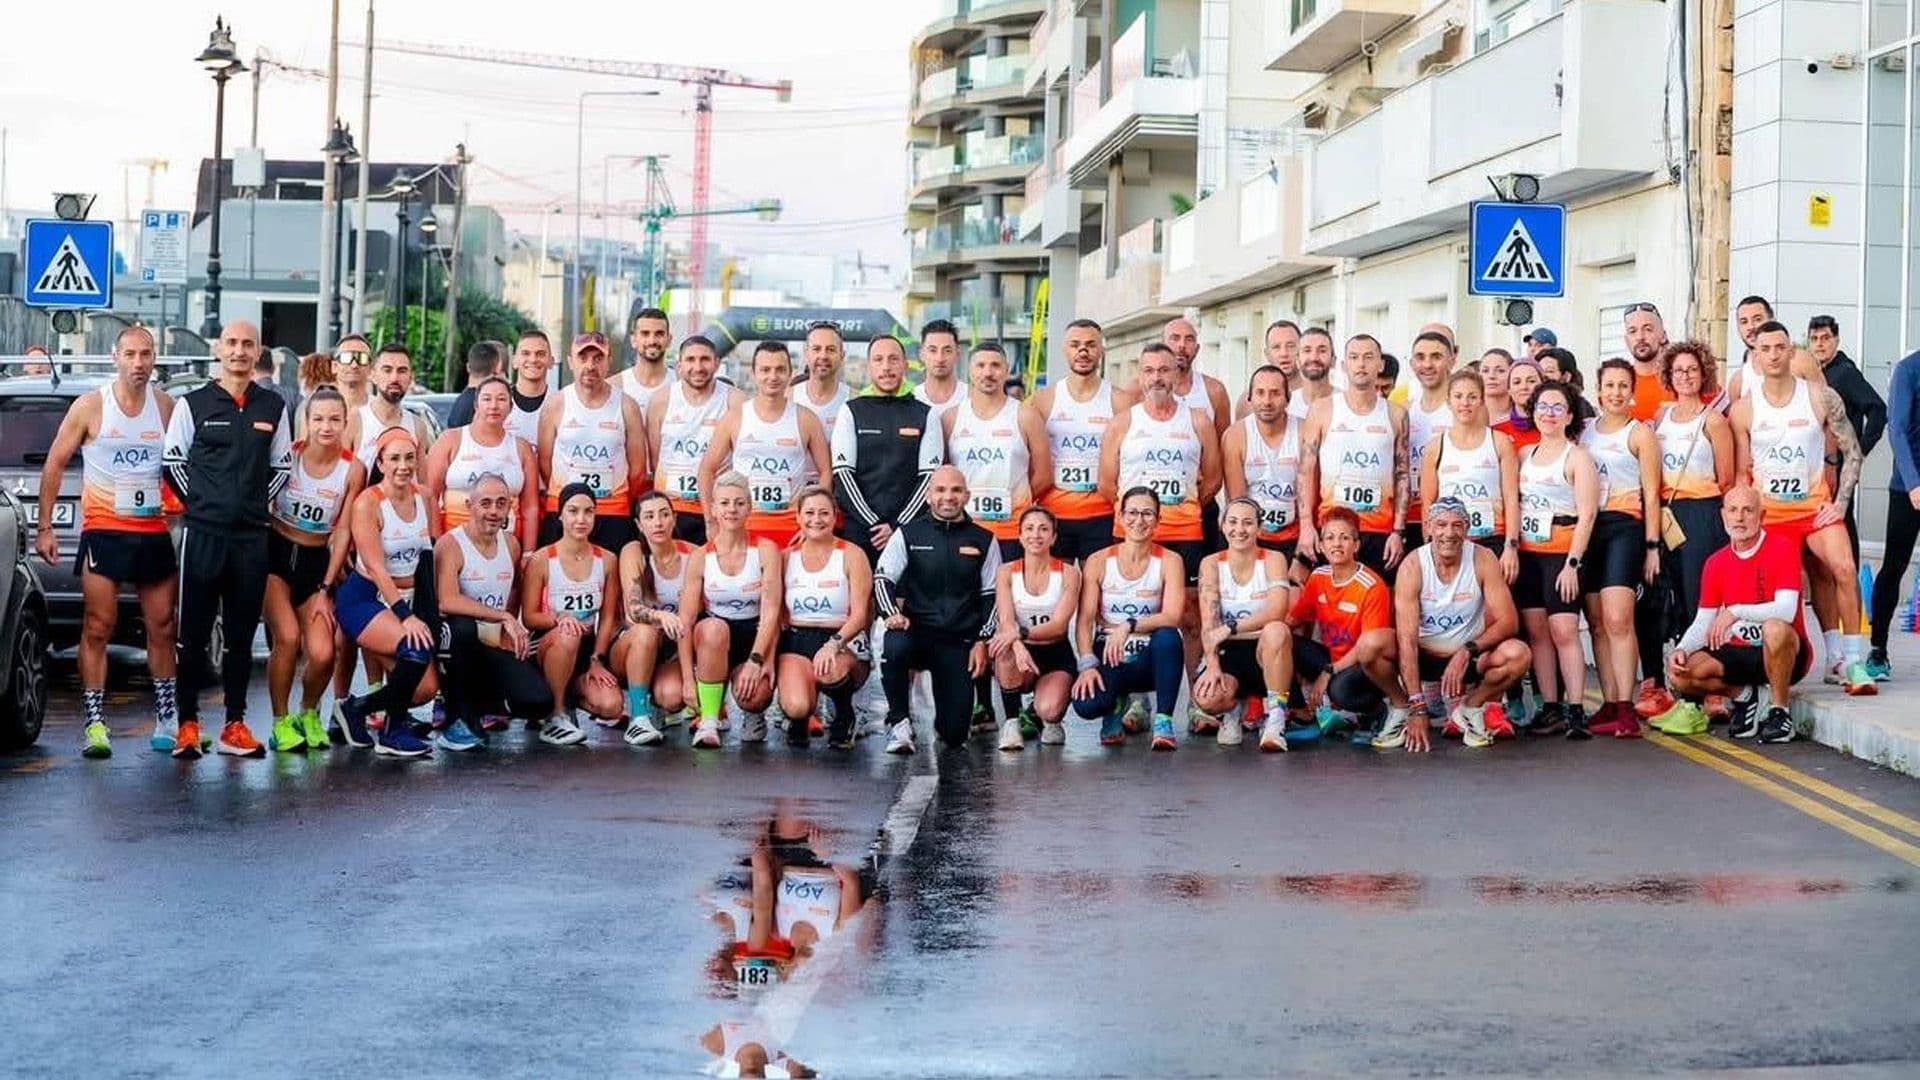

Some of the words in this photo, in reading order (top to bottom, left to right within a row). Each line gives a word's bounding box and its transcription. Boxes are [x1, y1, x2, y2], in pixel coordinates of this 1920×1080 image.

[1061, 435, 1098, 452] AQA
[113, 448, 151, 468] AQA
[571, 444, 609, 461] AQA
[966, 448, 1004, 464] AQA
[1145, 449, 1183, 465] AQA
[1343, 451, 1380, 468] AQA
[1769, 445, 1805, 462] AQA
[751, 457, 790, 474] AQA
[581, 474, 601, 488] 73
[1062, 468, 1090, 483] 231
[1150, 480, 1180, 495] 270
[1258, 483, 1294, 499] AQA
[1453, 484, 1488, 499] AQA
[1769, 478, 1801, 493] 272
[135, 490, 145, 507] 9
[752, 486, 782, 502] 183
[1344, 487, 1373, 504] 106
[292, 501, 324, 522] 130
[973, 497, 1003, 512] 196
[1522, 516, 1540, 533] 36
[564, 594, 594, 610] 213
[793, 596, 832, 613] AQA
[1426, 615, 1465, 630] AQA
[1739, 624, 1762, 640] 20
